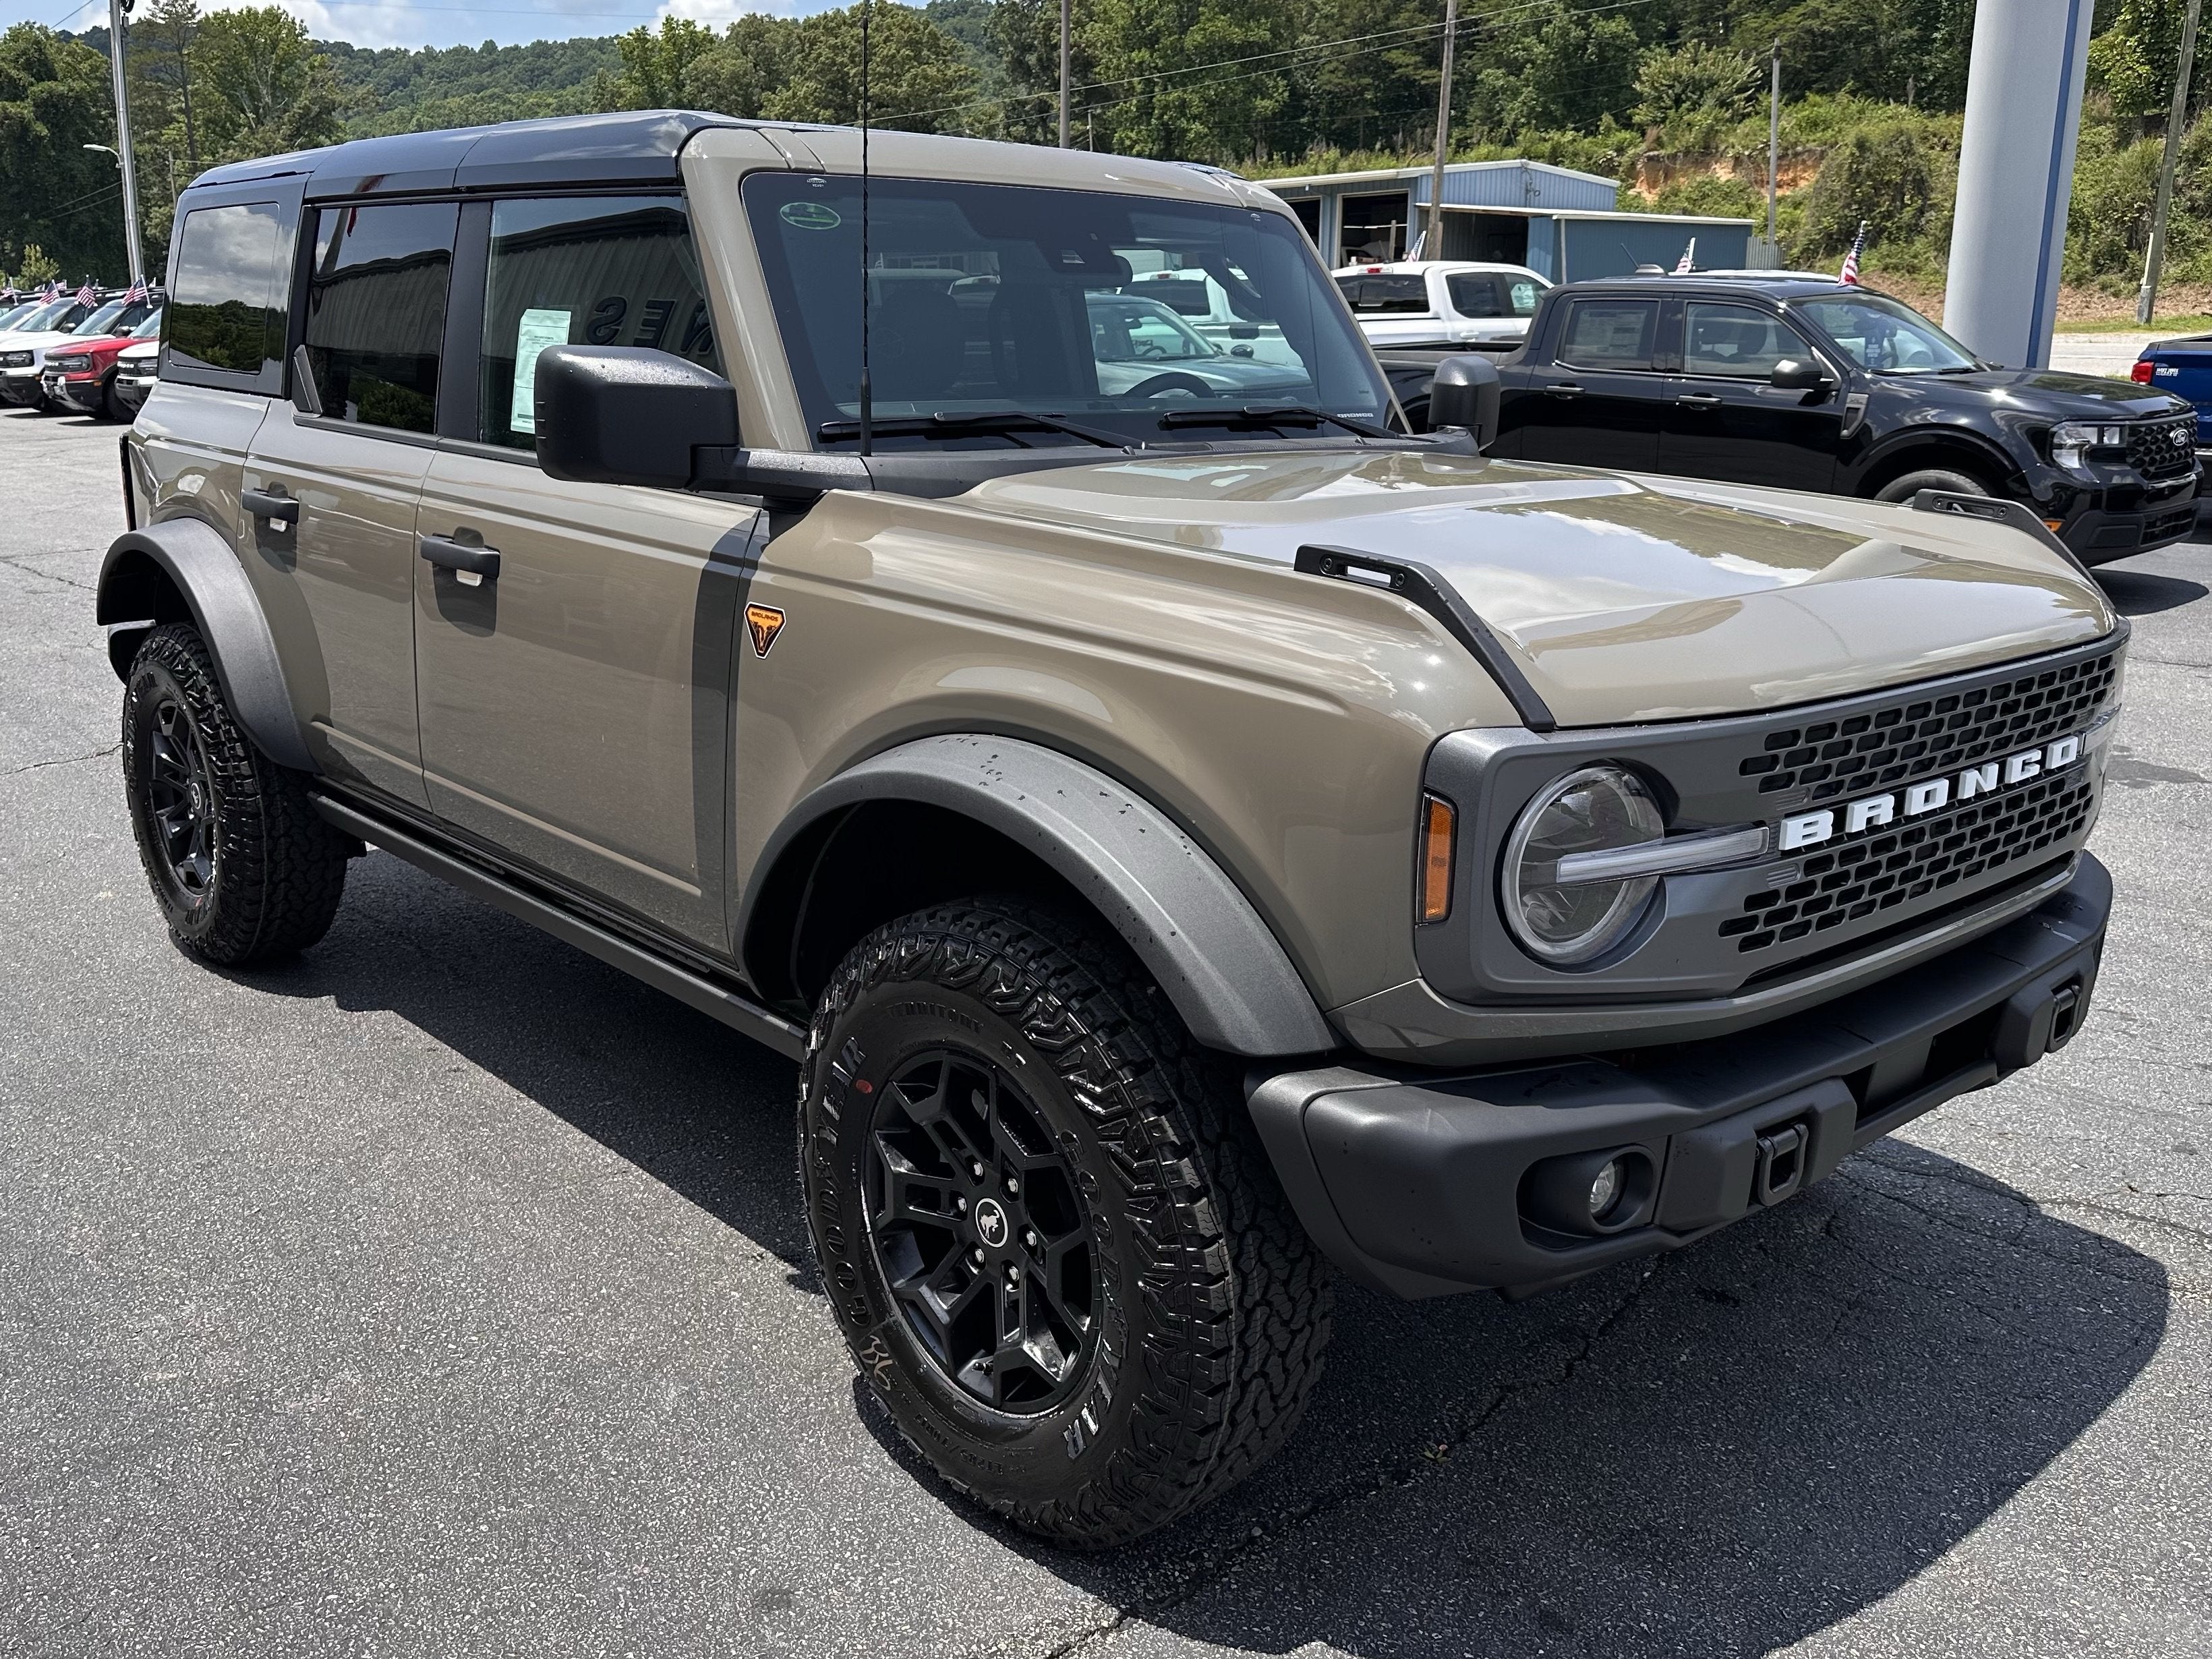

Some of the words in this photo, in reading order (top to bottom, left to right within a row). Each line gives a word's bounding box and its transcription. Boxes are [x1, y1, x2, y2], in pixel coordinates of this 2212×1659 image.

[751, 611, 779, 622] BADLANDS
[1778, 736, 2079, 851] BRONCO
[812, 1035, 868, 1327] GOODYEAR
[1060, 1128, 1129, 1460] GOODYEAR
